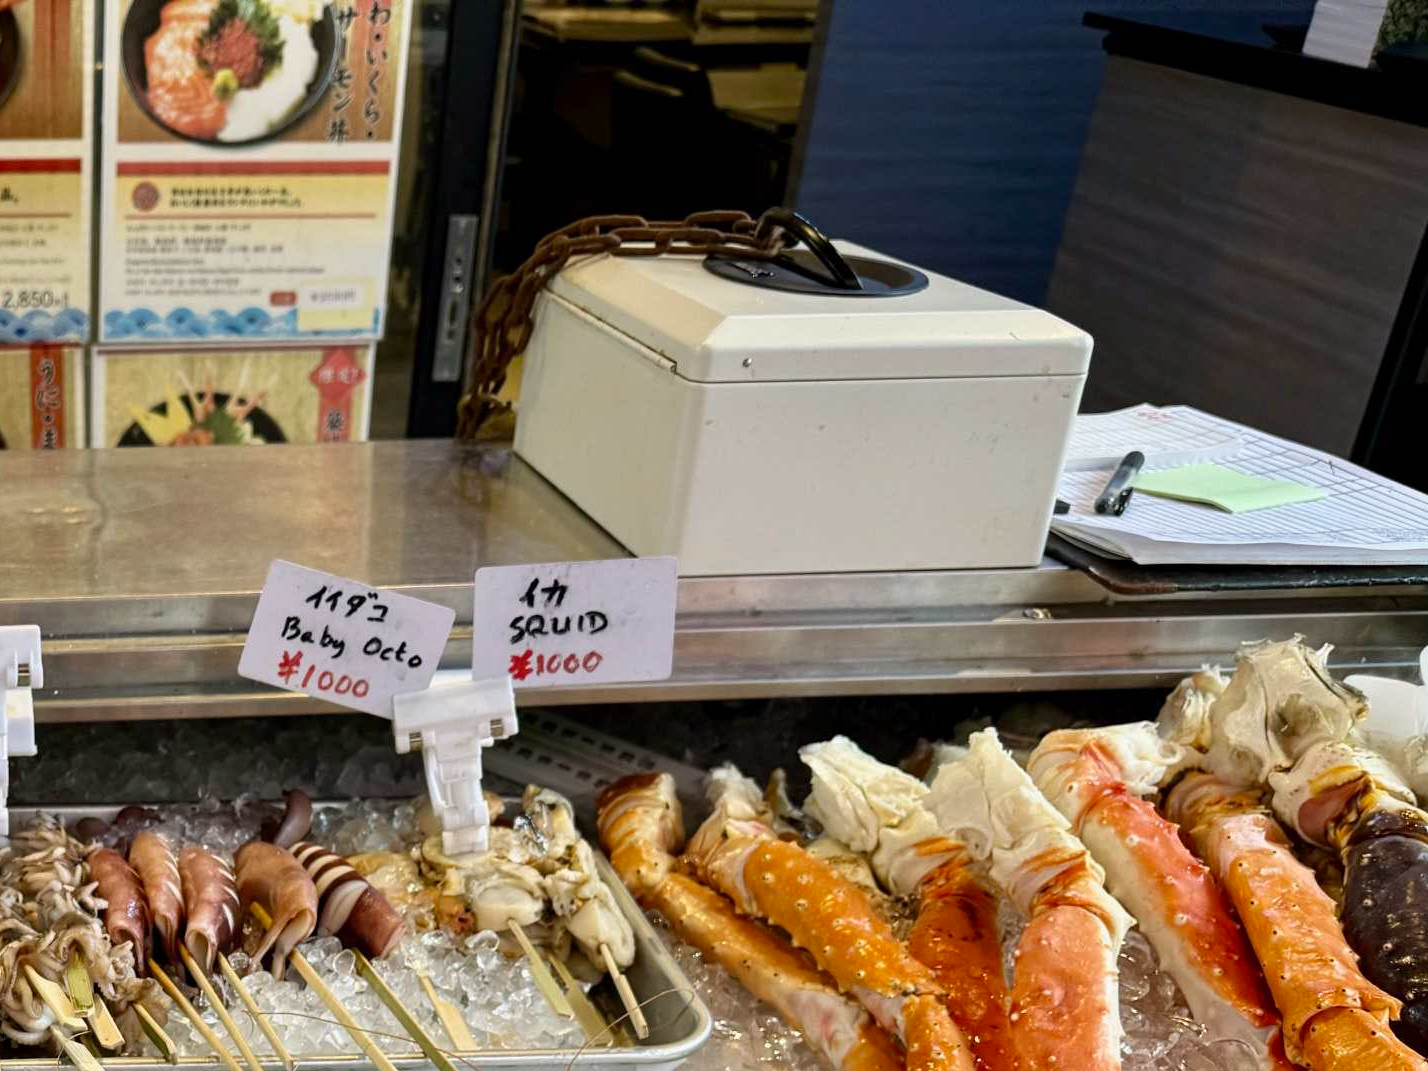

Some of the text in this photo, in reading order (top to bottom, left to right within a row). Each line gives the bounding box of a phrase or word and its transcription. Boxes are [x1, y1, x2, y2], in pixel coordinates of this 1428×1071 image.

[519, 577, 568, 607] イカ
[281, 616, 422, 668] Baby Octo
[508, 611, 609, 644] SQUID
[277, 650, 369, 698] ¥1000
[508, 649, 604, 681] ¥1000
